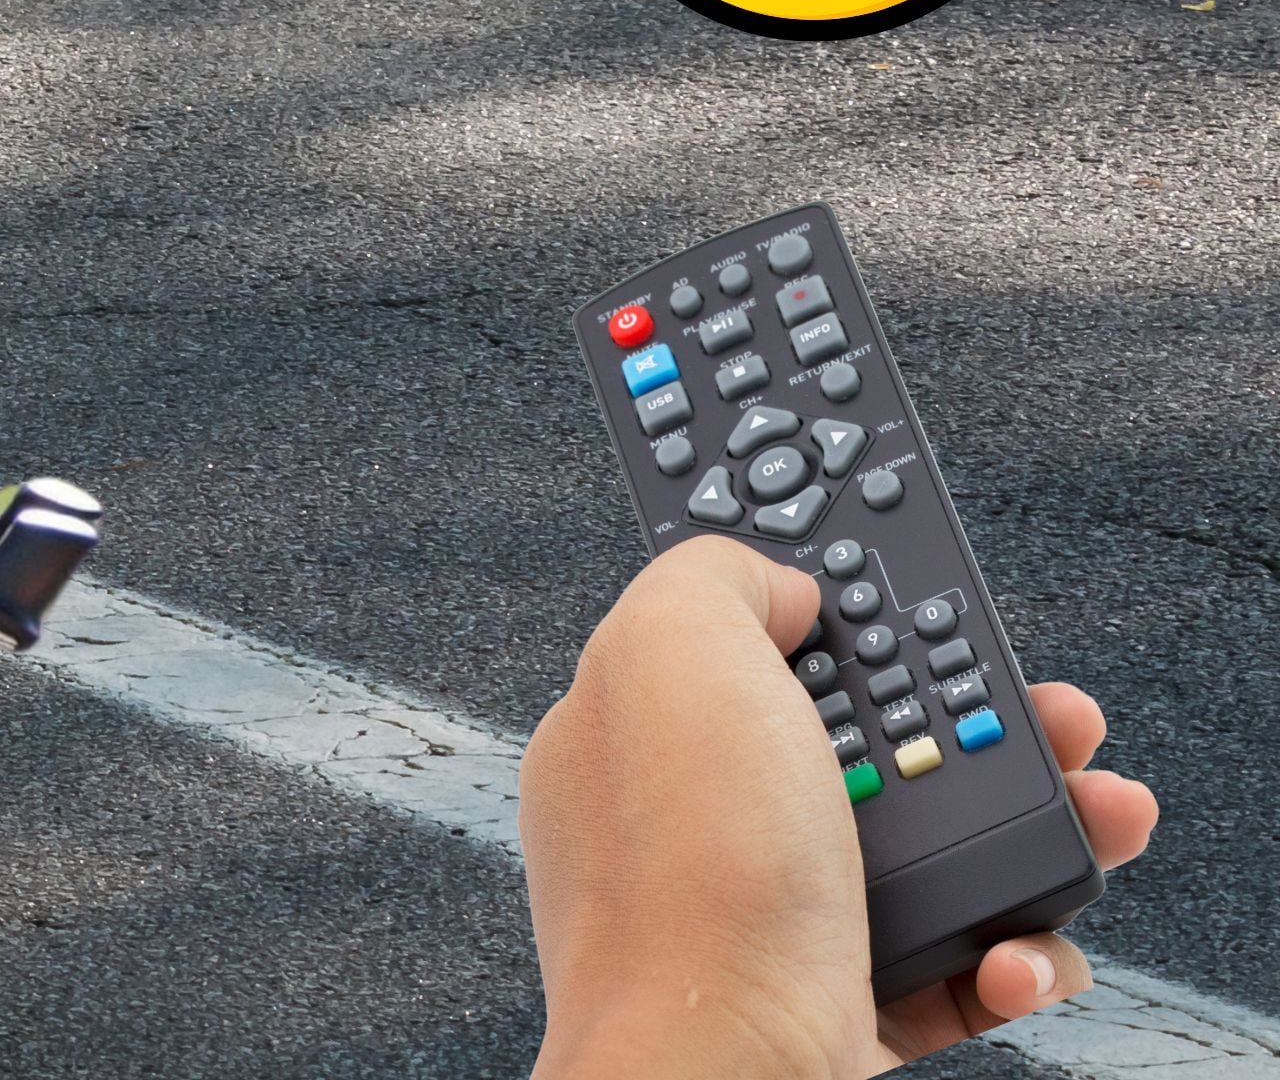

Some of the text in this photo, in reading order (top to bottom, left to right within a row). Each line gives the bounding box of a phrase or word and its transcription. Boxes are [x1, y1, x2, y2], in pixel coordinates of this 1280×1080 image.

[710, 251, 747, 273] AUDIO
[672, 277, 689, 294] AD
[799, 323, 831, 343] INFO
[720, 351, 753, 370] STOP
[788, 344, 872, 387] RETURN/EXIT
[647, 392, 674, 410] USB
[739, 395, 763, 409] CH+
[877, 419, 904, 434] VOL+
[650, 426, 688, 450] MENU
[762, 458, 788, 477] OK
[884, 452, 917, 471] DOWN
[654, 520, 680, 535] VOL-
[795, 544, 819, 559] CH-
[835, 546, 848, 560] 3
[853, 589, 864, 602] 6
[926, 606, 938, 620] 0
[867, 632, 878, 647] 9
[807, 659, 820, 672] 8
[883, 693, 915, 713] TEXT
